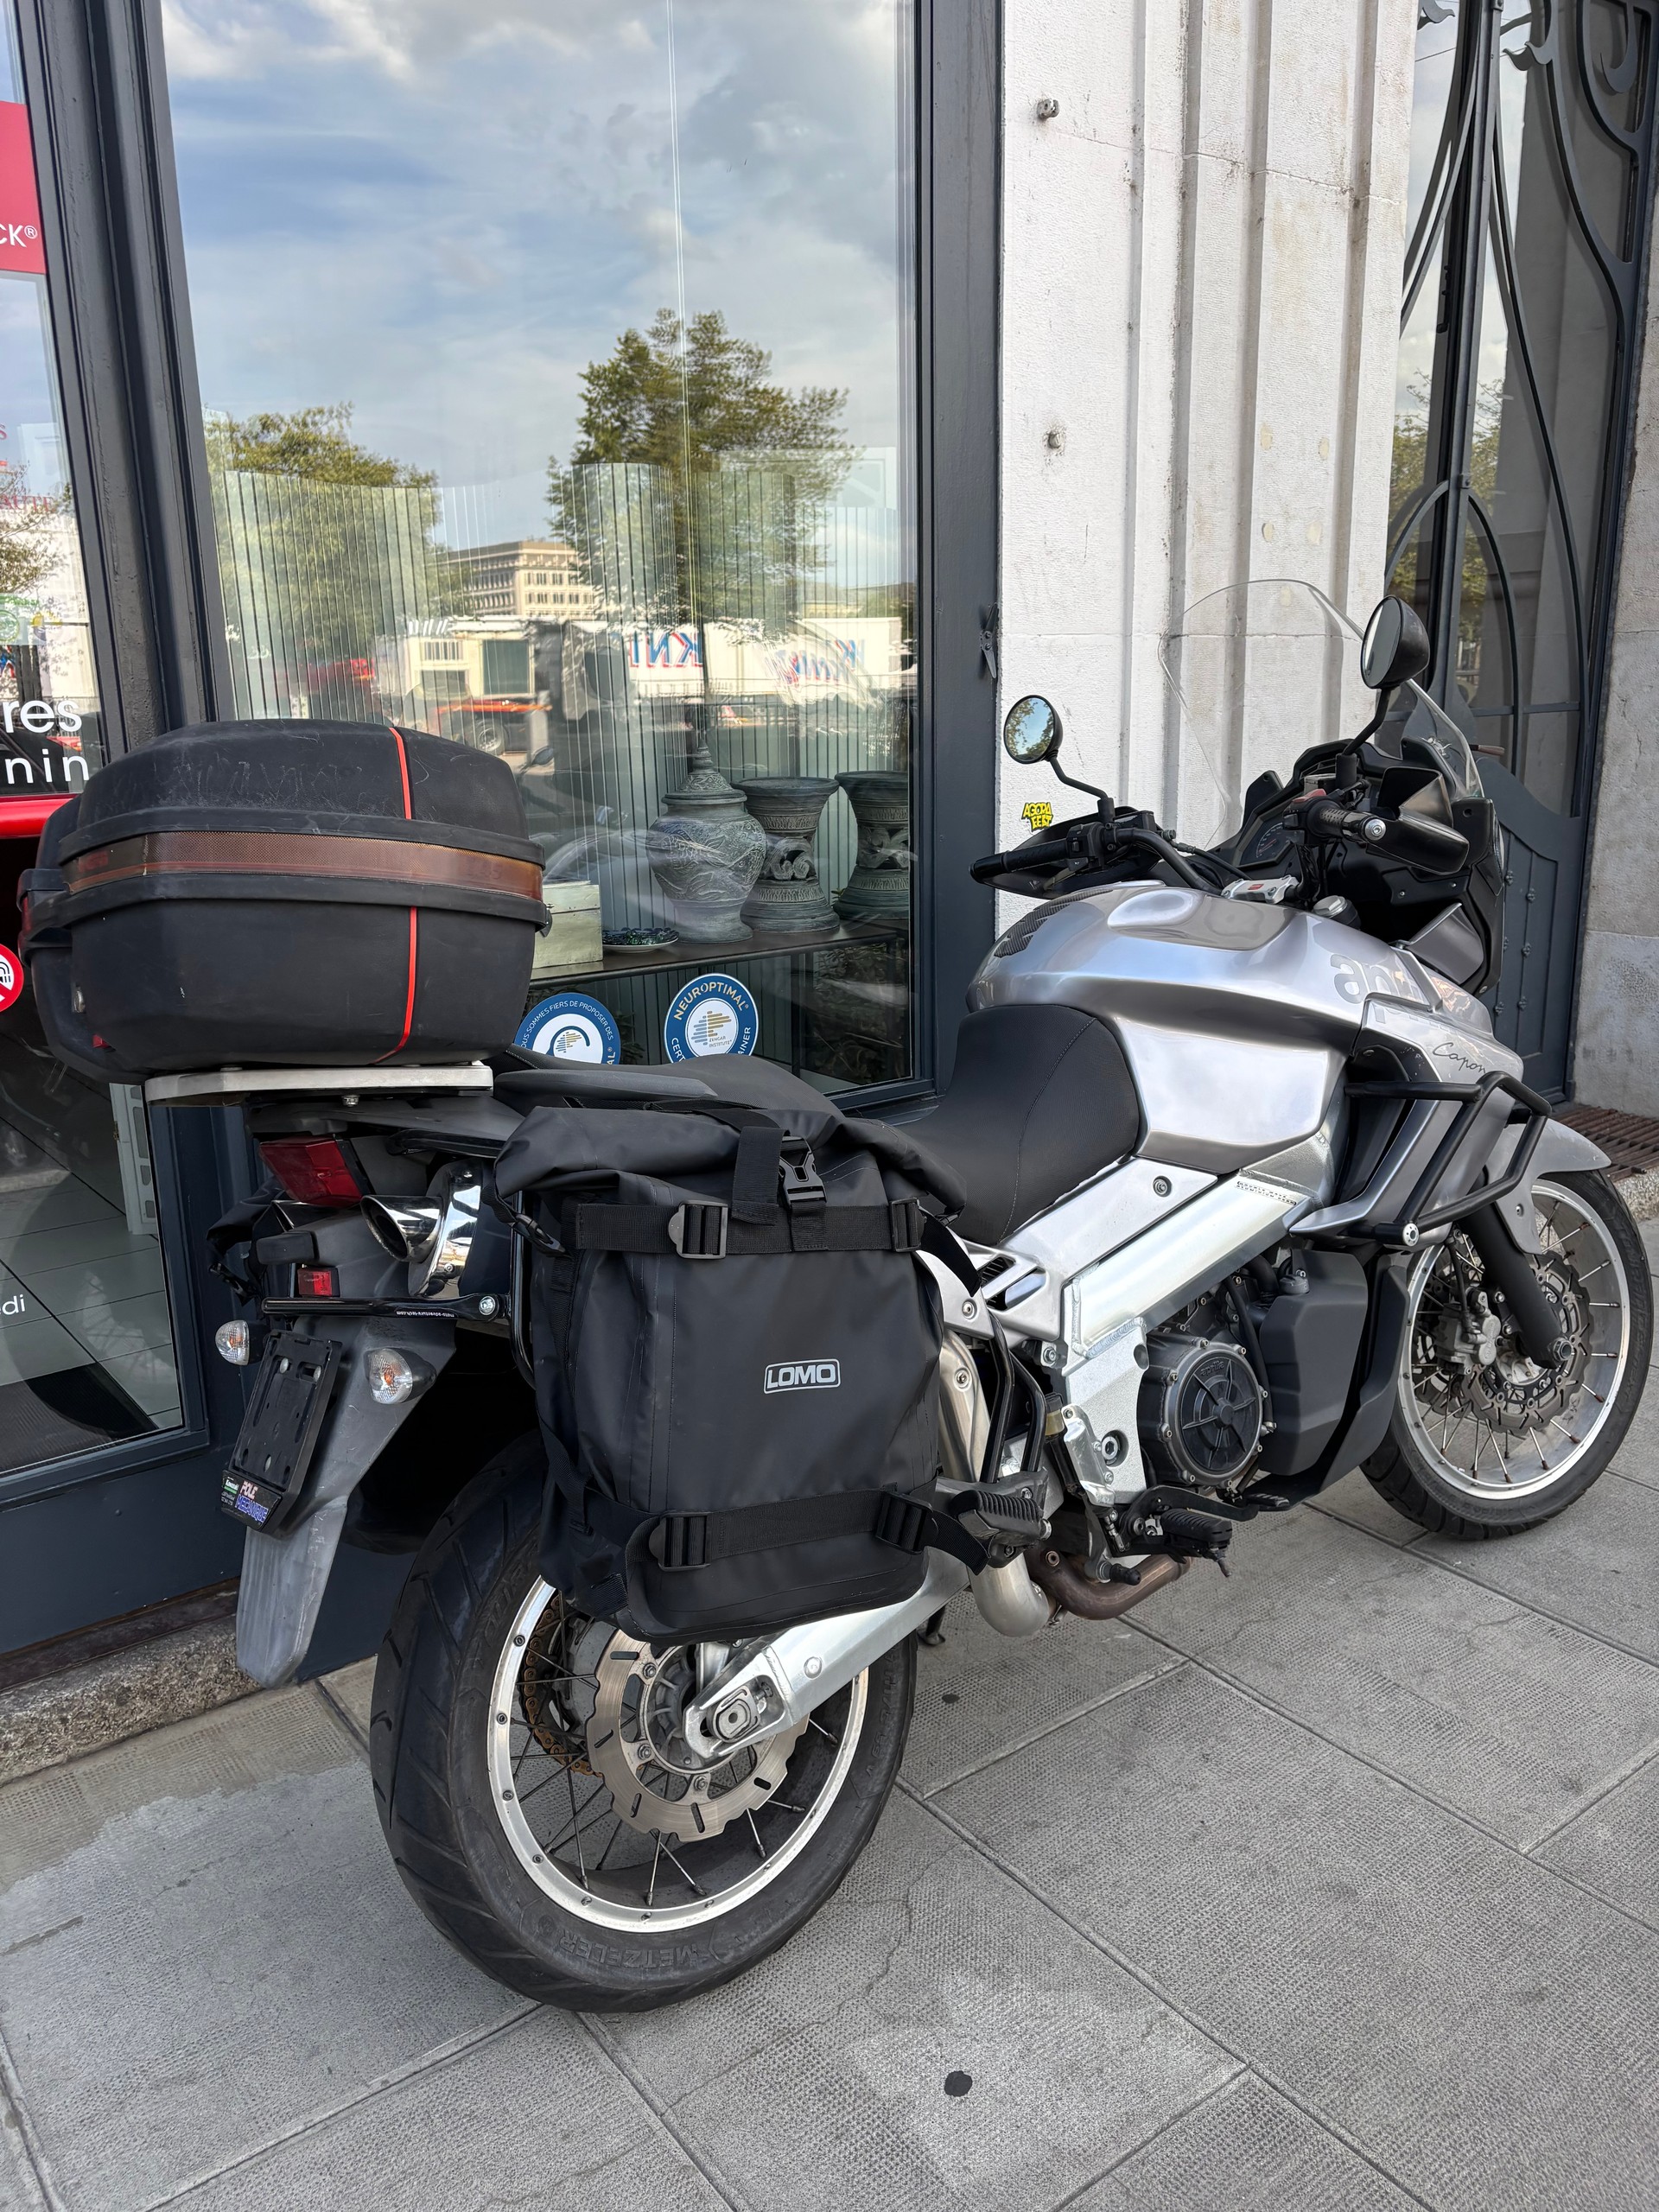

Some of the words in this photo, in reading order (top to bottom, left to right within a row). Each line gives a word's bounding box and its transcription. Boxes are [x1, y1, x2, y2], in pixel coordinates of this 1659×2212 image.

[2, 700, 82, 734] res
[4, 748, 90, 785] nin
[527, 1007, 550, 1033] SOMMES
[550, 1001, 569, 1012] FIERS
[579, 1001, 608, 1027] PROPOSER
[605, 1025, 614, 1041] DES
[0, 1294, 26, 1315] di
[766, 1363, 836, 1389] LOMO
[559, 1929, 698, 1969] METZELER
